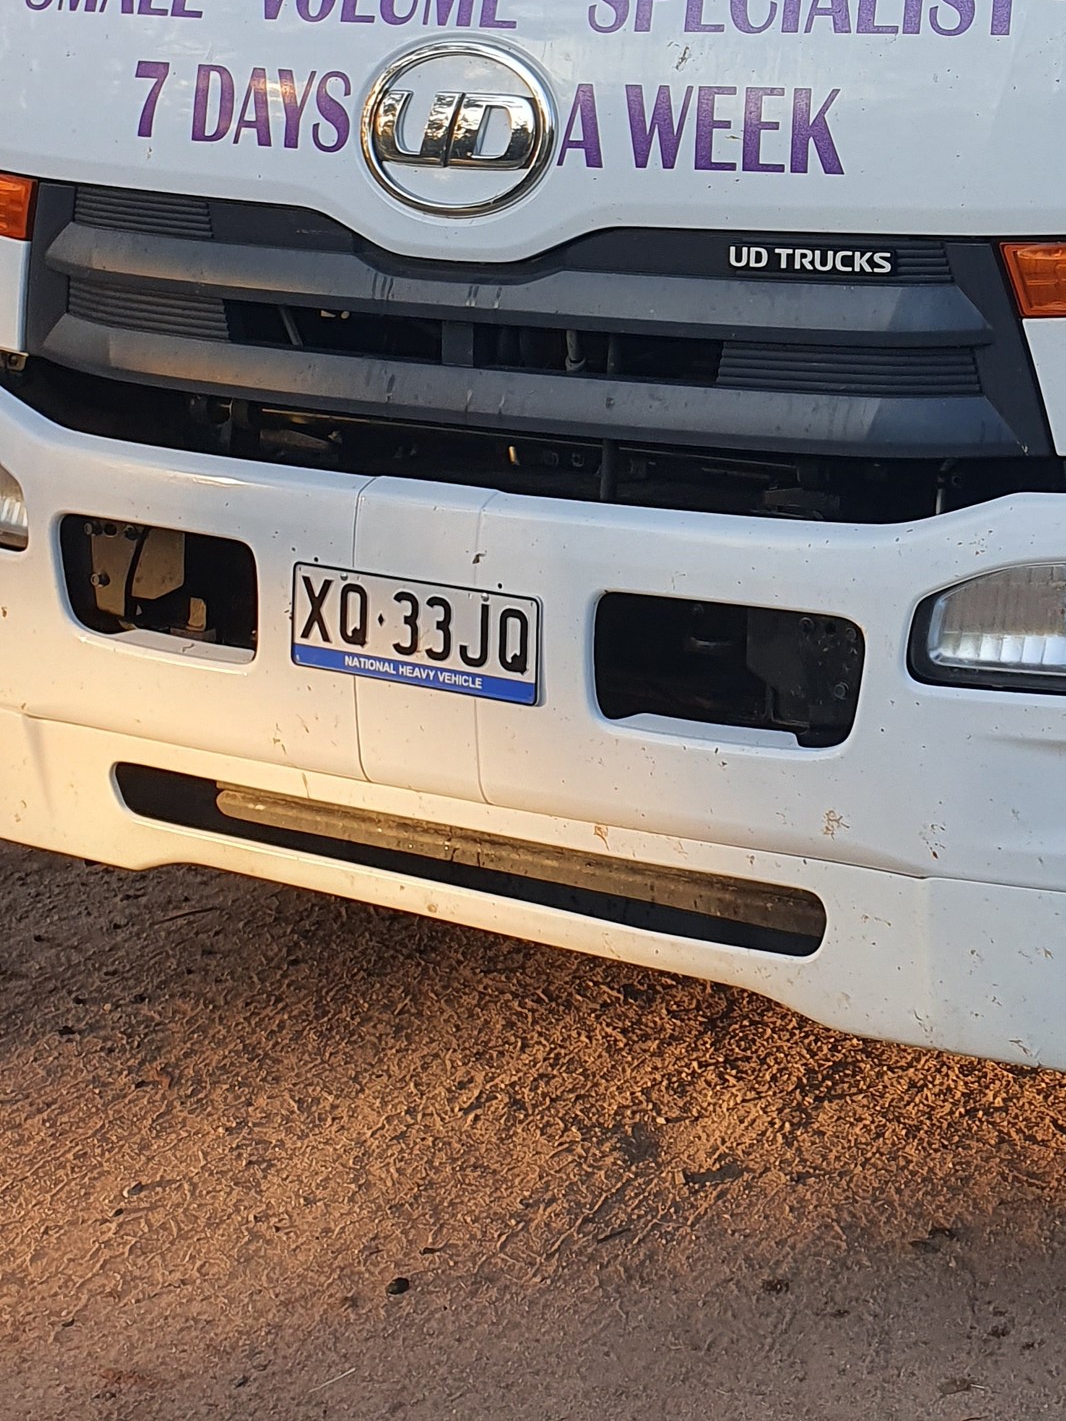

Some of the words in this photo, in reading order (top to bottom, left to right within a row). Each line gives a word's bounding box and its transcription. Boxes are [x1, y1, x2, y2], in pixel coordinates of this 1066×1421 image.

[134, 60, 171, 138] 7
[190, 62, 353, 153] DAYS
[555, 83, 604, 169] A
[623, 83, 845, 176] WEEK
[729, 245, 769, 268] UD
[774, 247, 893, 274] TRUCKS
[344, 654, 397, 675] NATIONAL
[398, 666, 436, 682] HEAVY
[436, 671, 484, 690] VEHICLE
